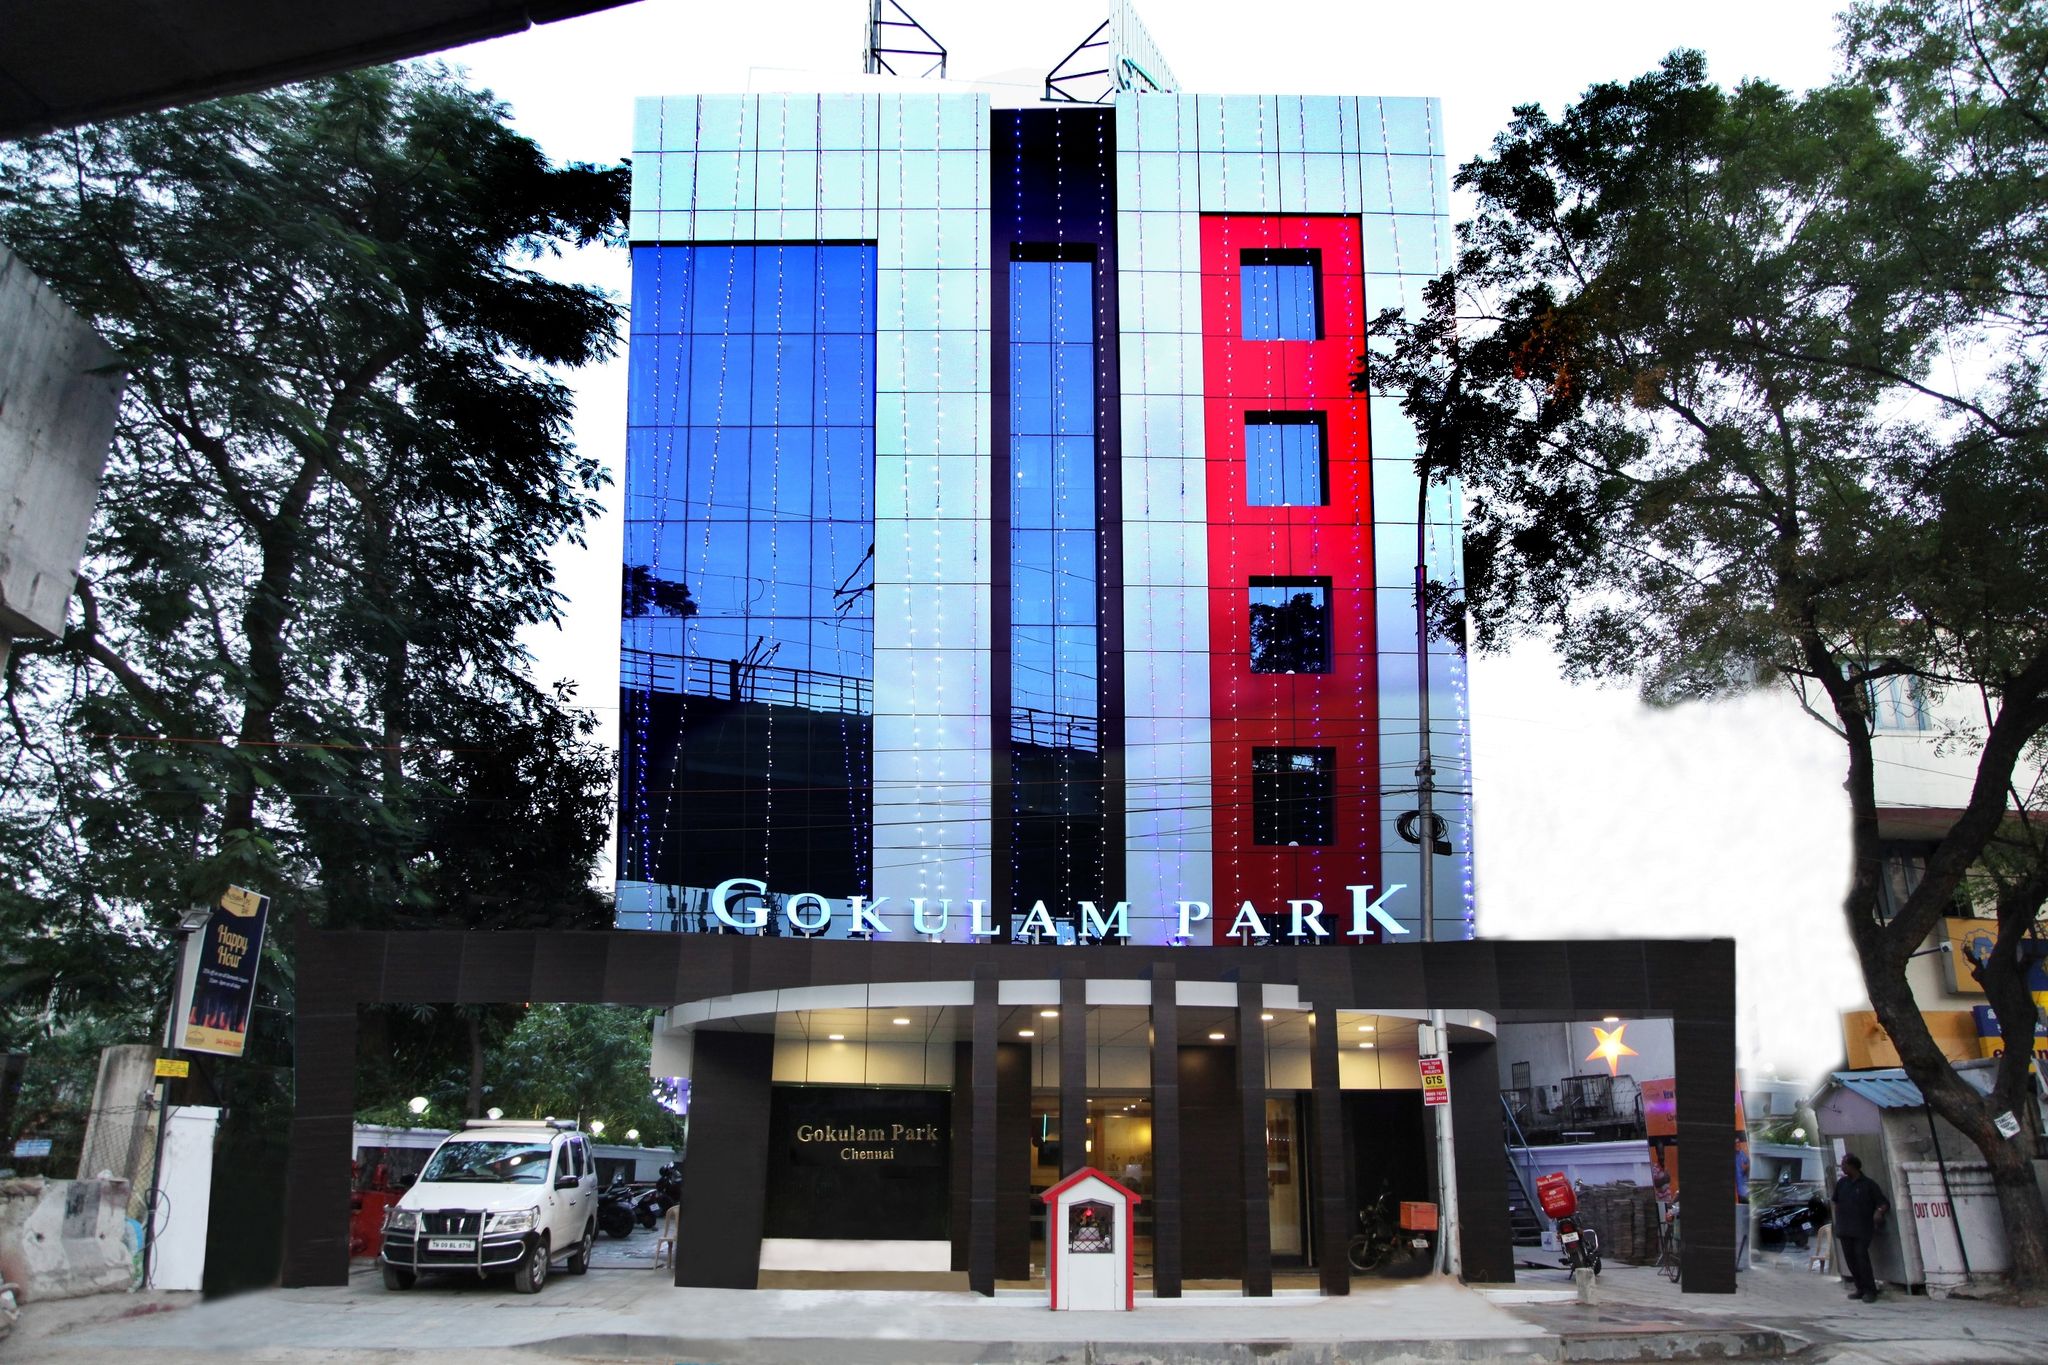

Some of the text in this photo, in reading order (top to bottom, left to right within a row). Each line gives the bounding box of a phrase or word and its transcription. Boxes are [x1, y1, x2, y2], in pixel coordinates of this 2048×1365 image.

[712, 878, 1410, 937] GOKULAM PARK
[217, 923, 249, 956] Happy
[217, 945, 242, 968] Hour
[1425, 1075, 1443, 1085] GTS
[797, 1124, 939, 1142] Gokulam Park
[840, 1148, 895, 1161] Chennai
[1914, 1203, 1950, 1219] OUT OUT
